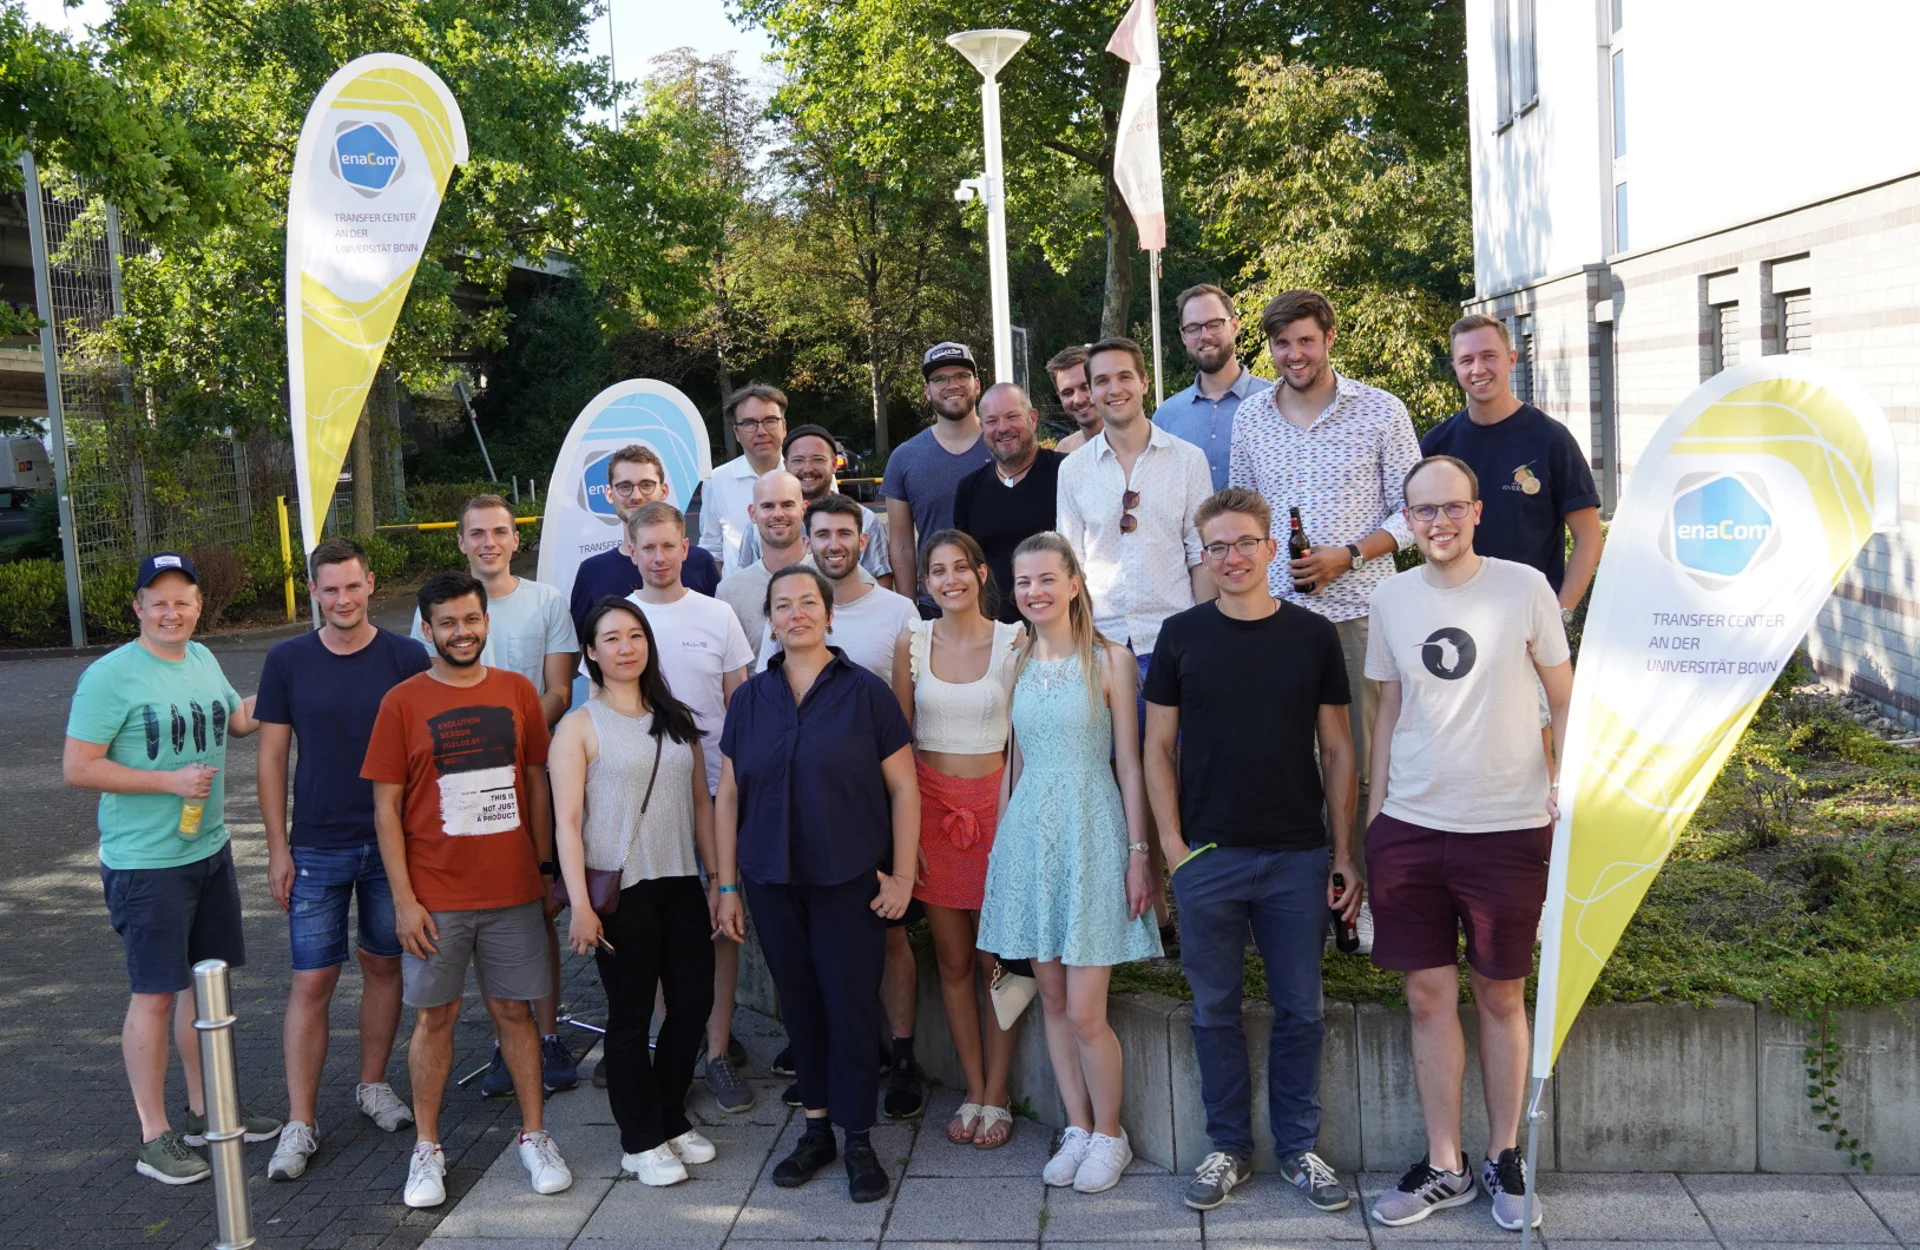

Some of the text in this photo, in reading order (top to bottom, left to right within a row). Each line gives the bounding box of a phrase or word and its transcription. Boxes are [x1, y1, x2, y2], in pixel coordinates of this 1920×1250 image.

[341, 152, 398, 166] enaCom
[334, 212, 417, 223] TRANSFER CENTER
[335, 229, 368, 238] AN DER
[335, 243, 418, 254] UNIVERSITÄT BONN
[1677, 520, 1770, 540] enaCom
[578, 539, 624, 554] TRANSFER
[1652, 612, 1785, 628] TRANSFER CENTER
[1648, 636, 1700, 650] AN DER
[1646, 658, 1778, 675] UNIVERSITÄT BONN
[438, 717, 480, 729] EVOLUTION
[441, 729, 470, 738] SEASON
[483, 803, 515, 813] NOT JUST
[483, 812, 516, 822] PRODUCT
